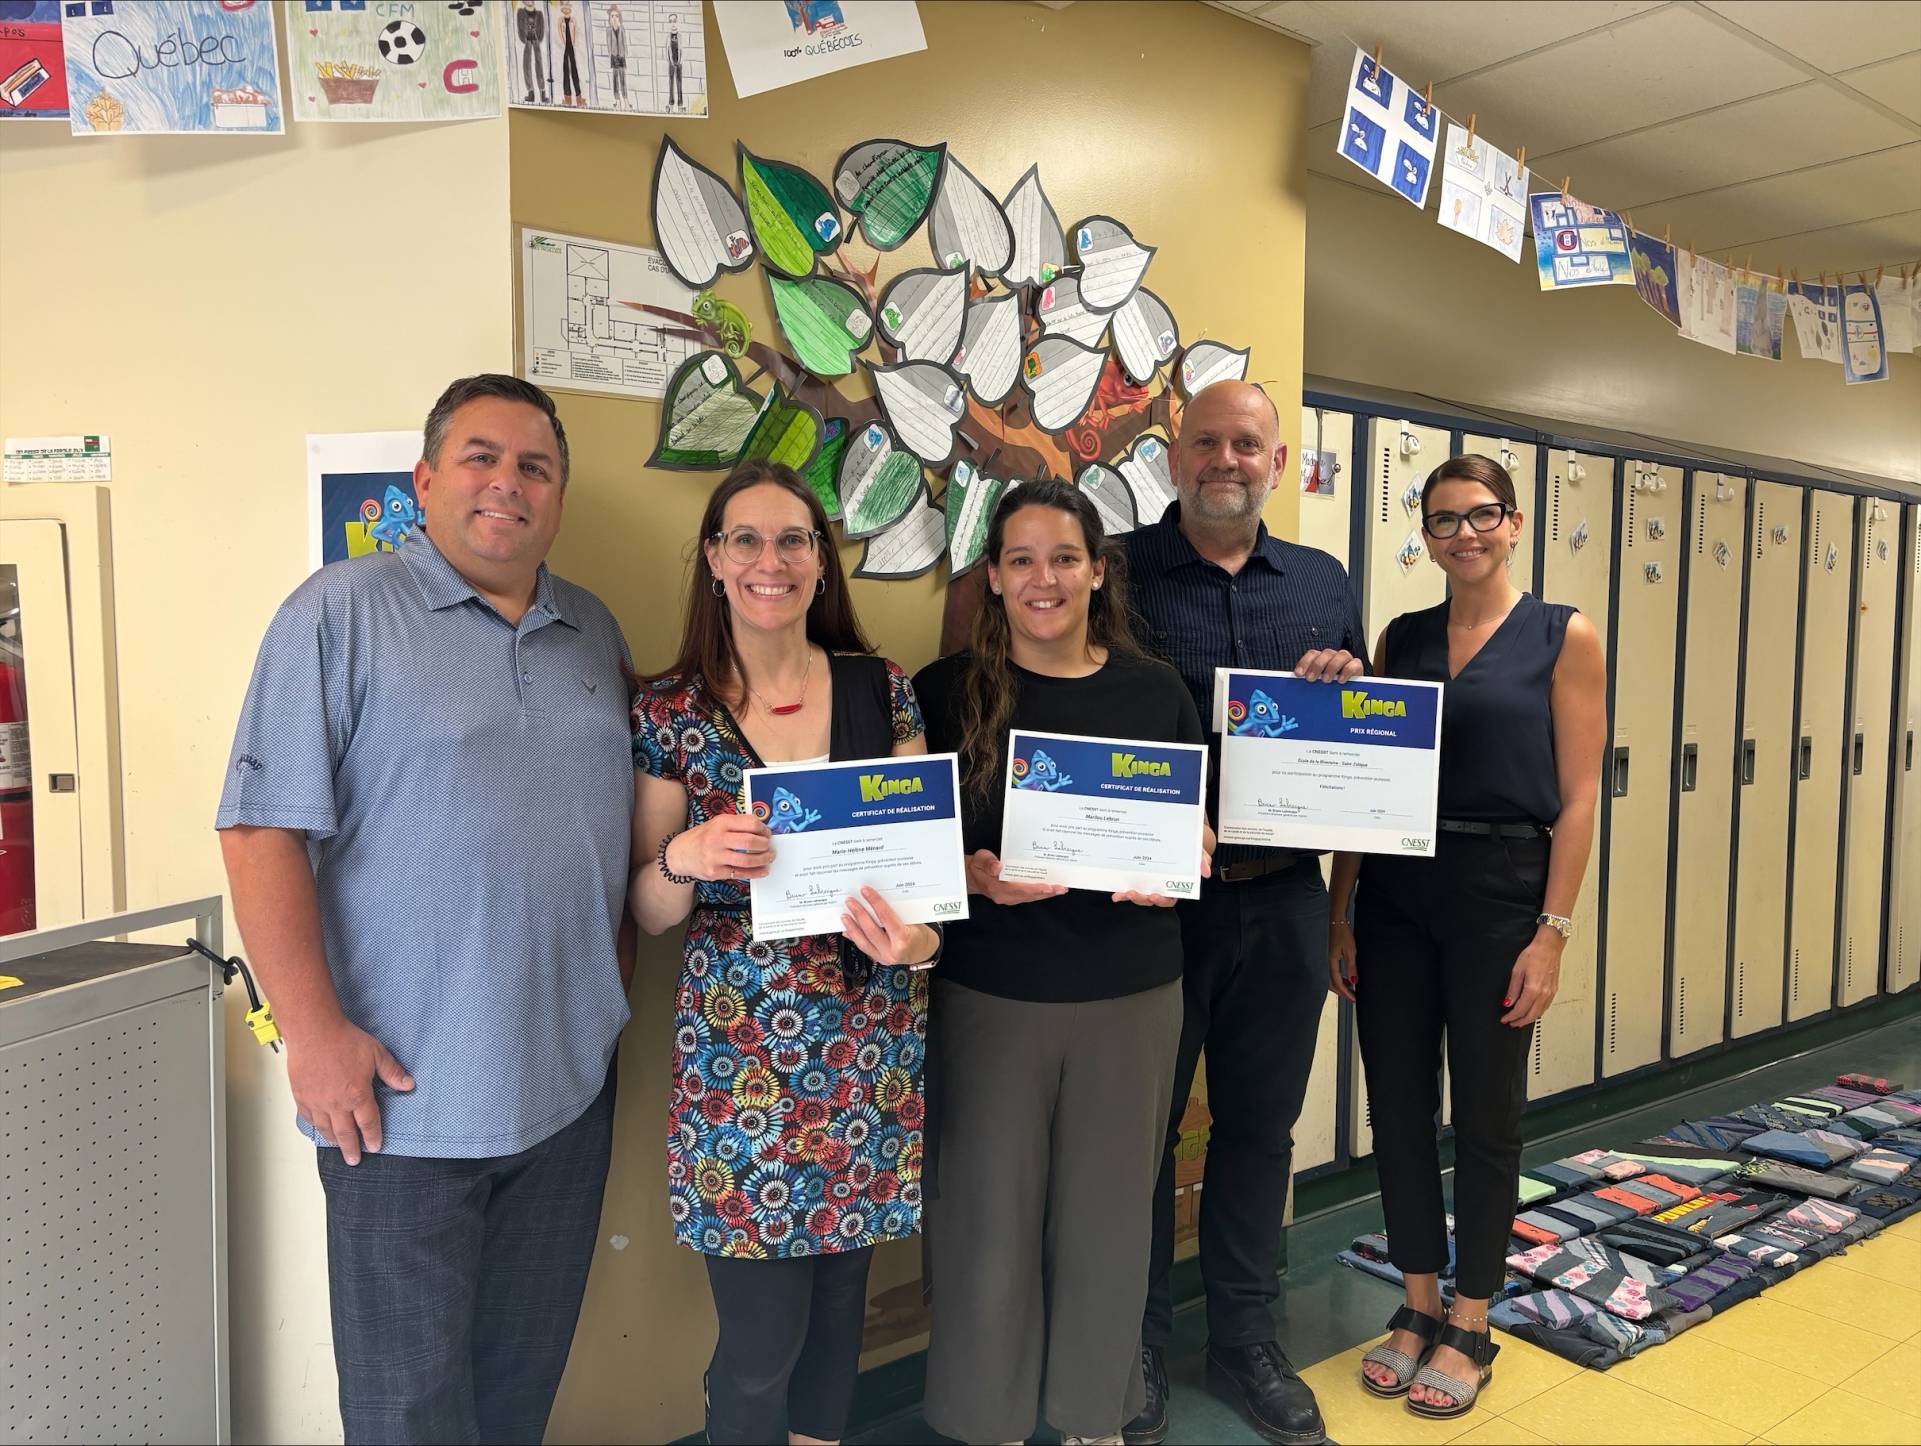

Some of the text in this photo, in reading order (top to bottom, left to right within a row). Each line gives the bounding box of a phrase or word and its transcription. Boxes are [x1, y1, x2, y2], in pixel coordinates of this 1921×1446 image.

[376, 4, 415, 17] CFM
[92, 27, 246, 79] Québec
[784, 46, 802, 58] 100%
[1350, 727, 1397, 737] PRIX RÉGIONAL
[1100, 783, 1133, 791] CERTIFICAT
[1142, 785, 1181, 795] RÉALISATION
[852, 804, 935, 818] CERTIFICAT DE RÉALISATION
[1401, 837, 1431, 848] CNESST
[1165, 880, 1194, 890] CNESST
[933, 901, 962, 912] CNESST
